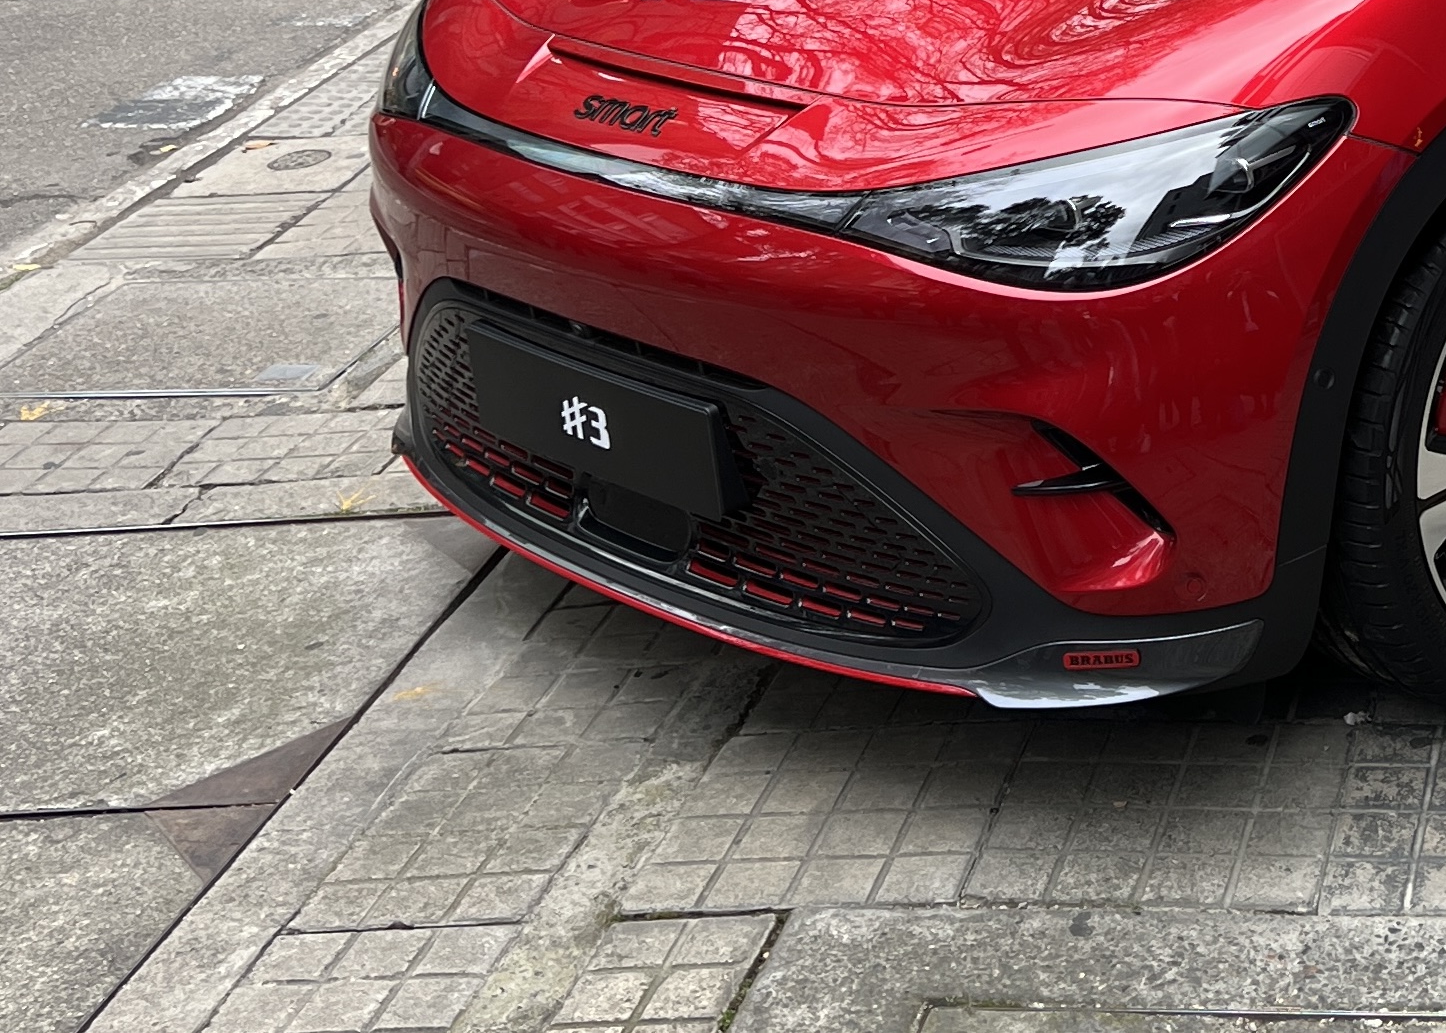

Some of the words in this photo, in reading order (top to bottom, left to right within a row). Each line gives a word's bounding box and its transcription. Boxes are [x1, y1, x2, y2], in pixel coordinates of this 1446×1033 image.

[574, 94, 679, 137] smart
[561, 396, 610, 449] #3
[1069, 653, 1134, 666] BRABUS
